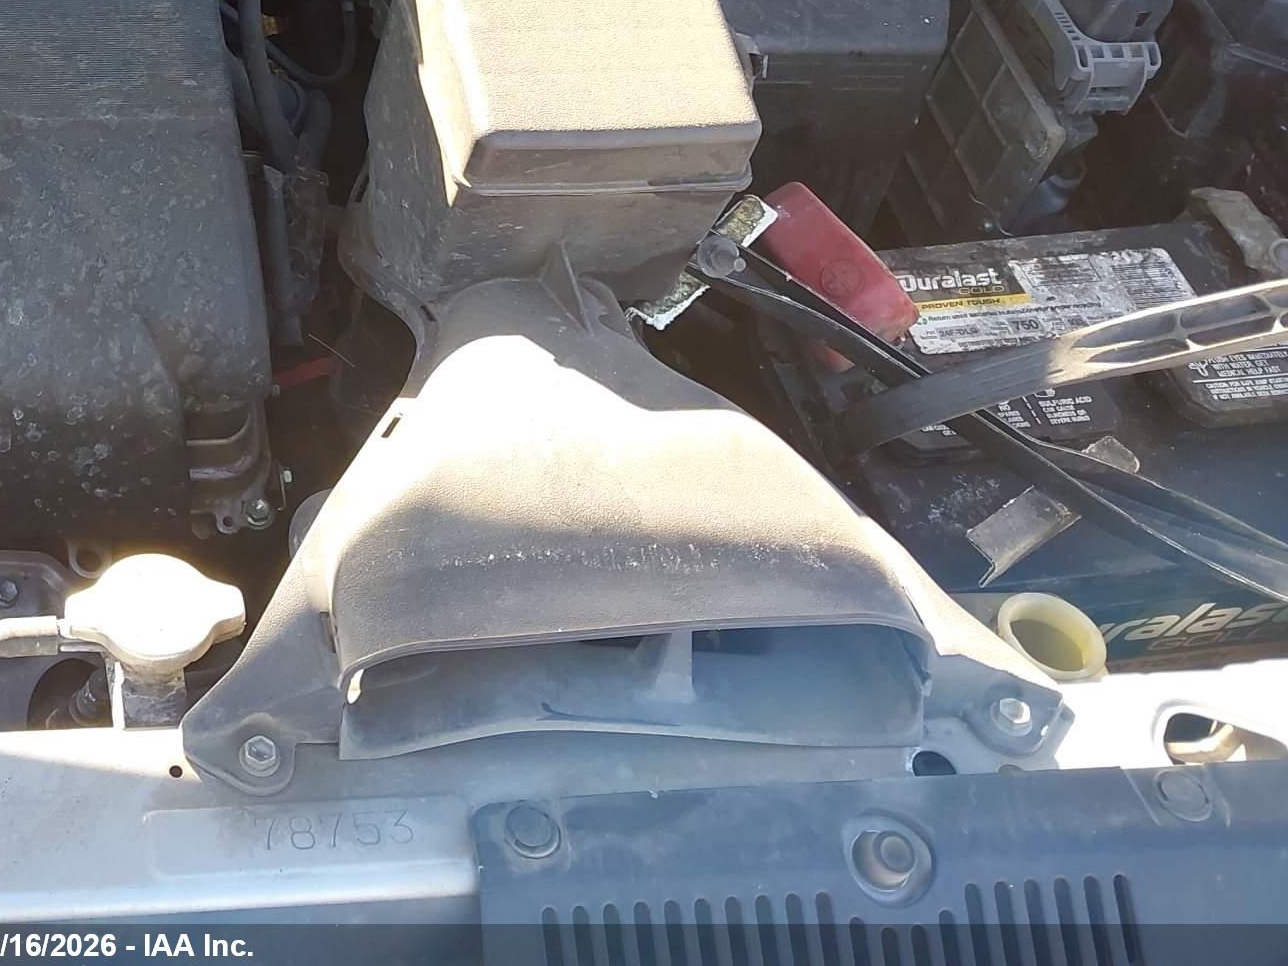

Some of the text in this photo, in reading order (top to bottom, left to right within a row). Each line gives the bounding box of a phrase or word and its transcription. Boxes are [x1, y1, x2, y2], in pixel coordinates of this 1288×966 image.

[921, 297, 1001, 310] PROVEN TOUGH
[1014, 319, 1040, 331] 750
[1038, 395, 1093, 407] SULFURIC ACID
[1099, 602, 1288, 643] ralas
[254, 808, 414, 851] 78753
